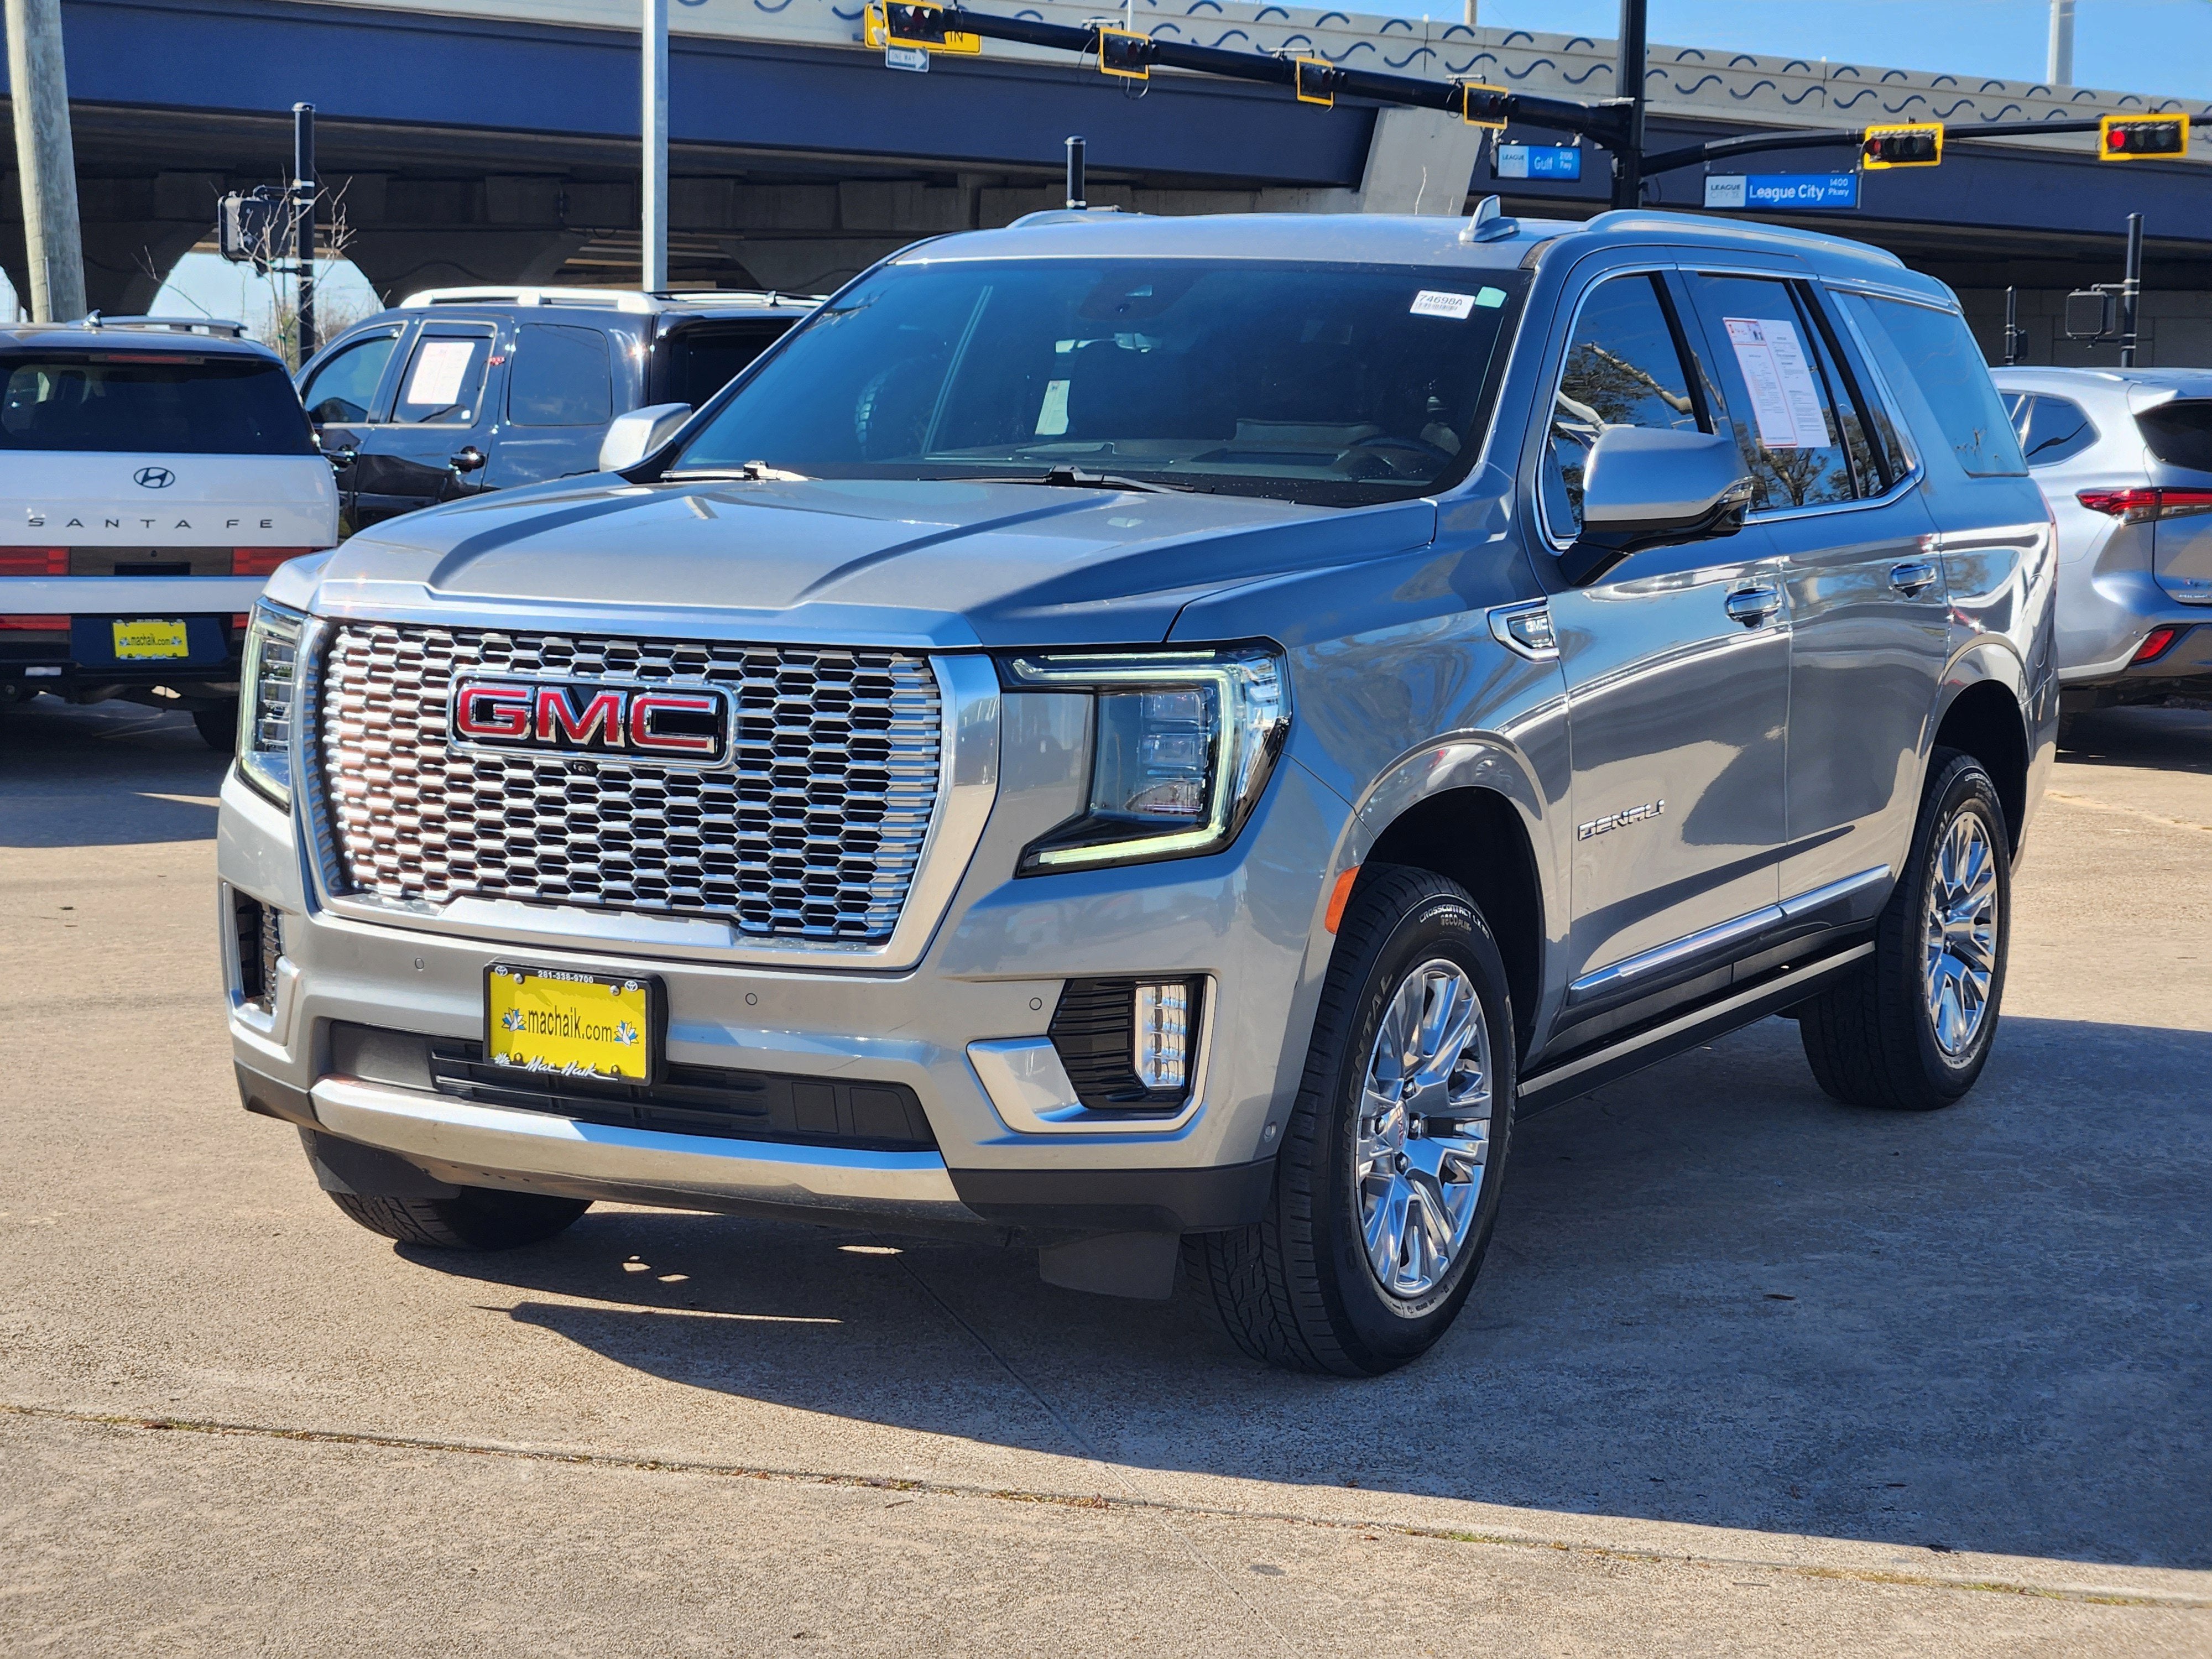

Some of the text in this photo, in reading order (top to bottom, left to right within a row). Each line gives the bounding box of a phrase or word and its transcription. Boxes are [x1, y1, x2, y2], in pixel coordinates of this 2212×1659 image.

[1534, 156, 1553, 170] Gulf
[1829, 178, 1849, 187] 1400
[1749, 184, 1824, 202] League City
[1828, 187, 1849, 197] Pkwy
[1419, 294, 1463, 306] 74698A
[28, 517, 273, 529] SANTA FE
[1525, 618, 1548, 633] GMC
[457, 682, 719, 754] GMC
[1578, 799, 1665, 842] DENALI
[538, 969, 594, 984] 281-338-9700
[528, 1005, 613, 1042] machaik.com
